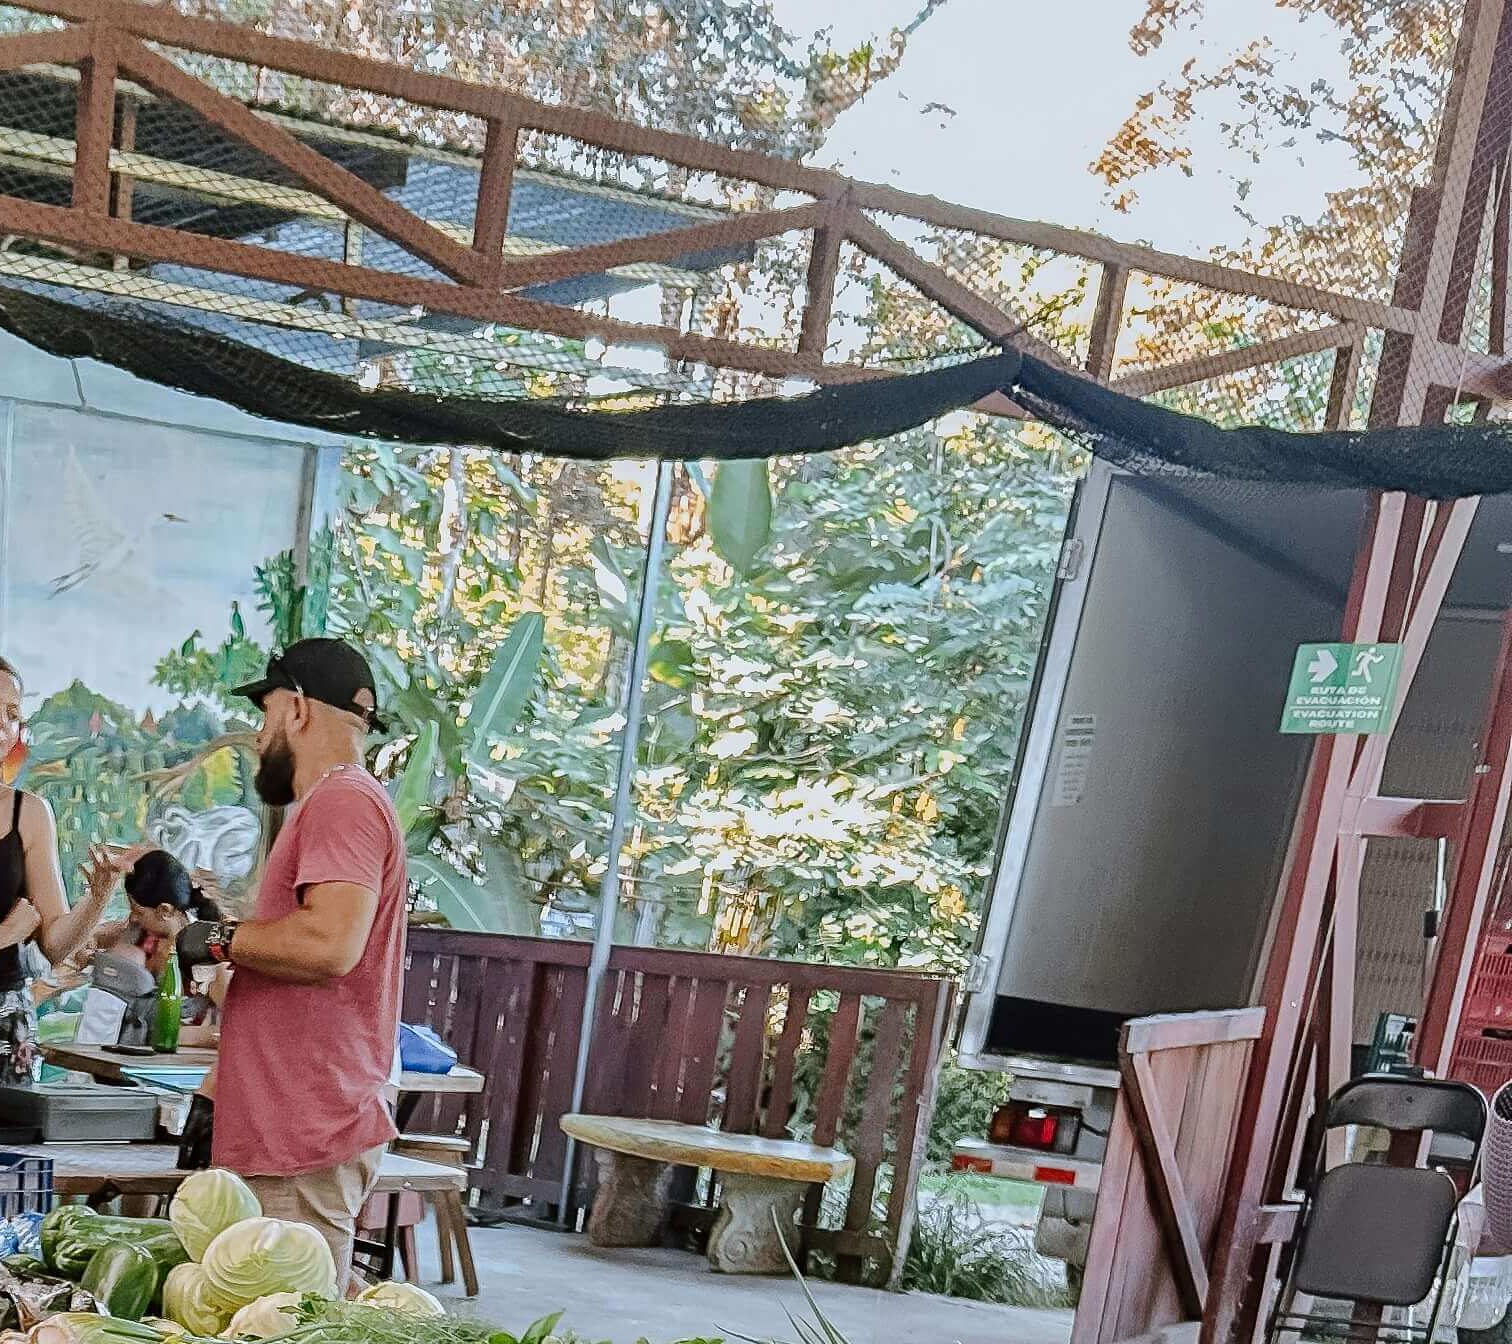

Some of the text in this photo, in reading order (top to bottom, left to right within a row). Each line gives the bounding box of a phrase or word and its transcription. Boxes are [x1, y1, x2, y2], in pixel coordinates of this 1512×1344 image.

[1296, 695, 1381, 705] EVACUACIÓN
[1292, 709, 1380, 719] EVACUATION
[1308, 719, 1355, 729] ROUTE
